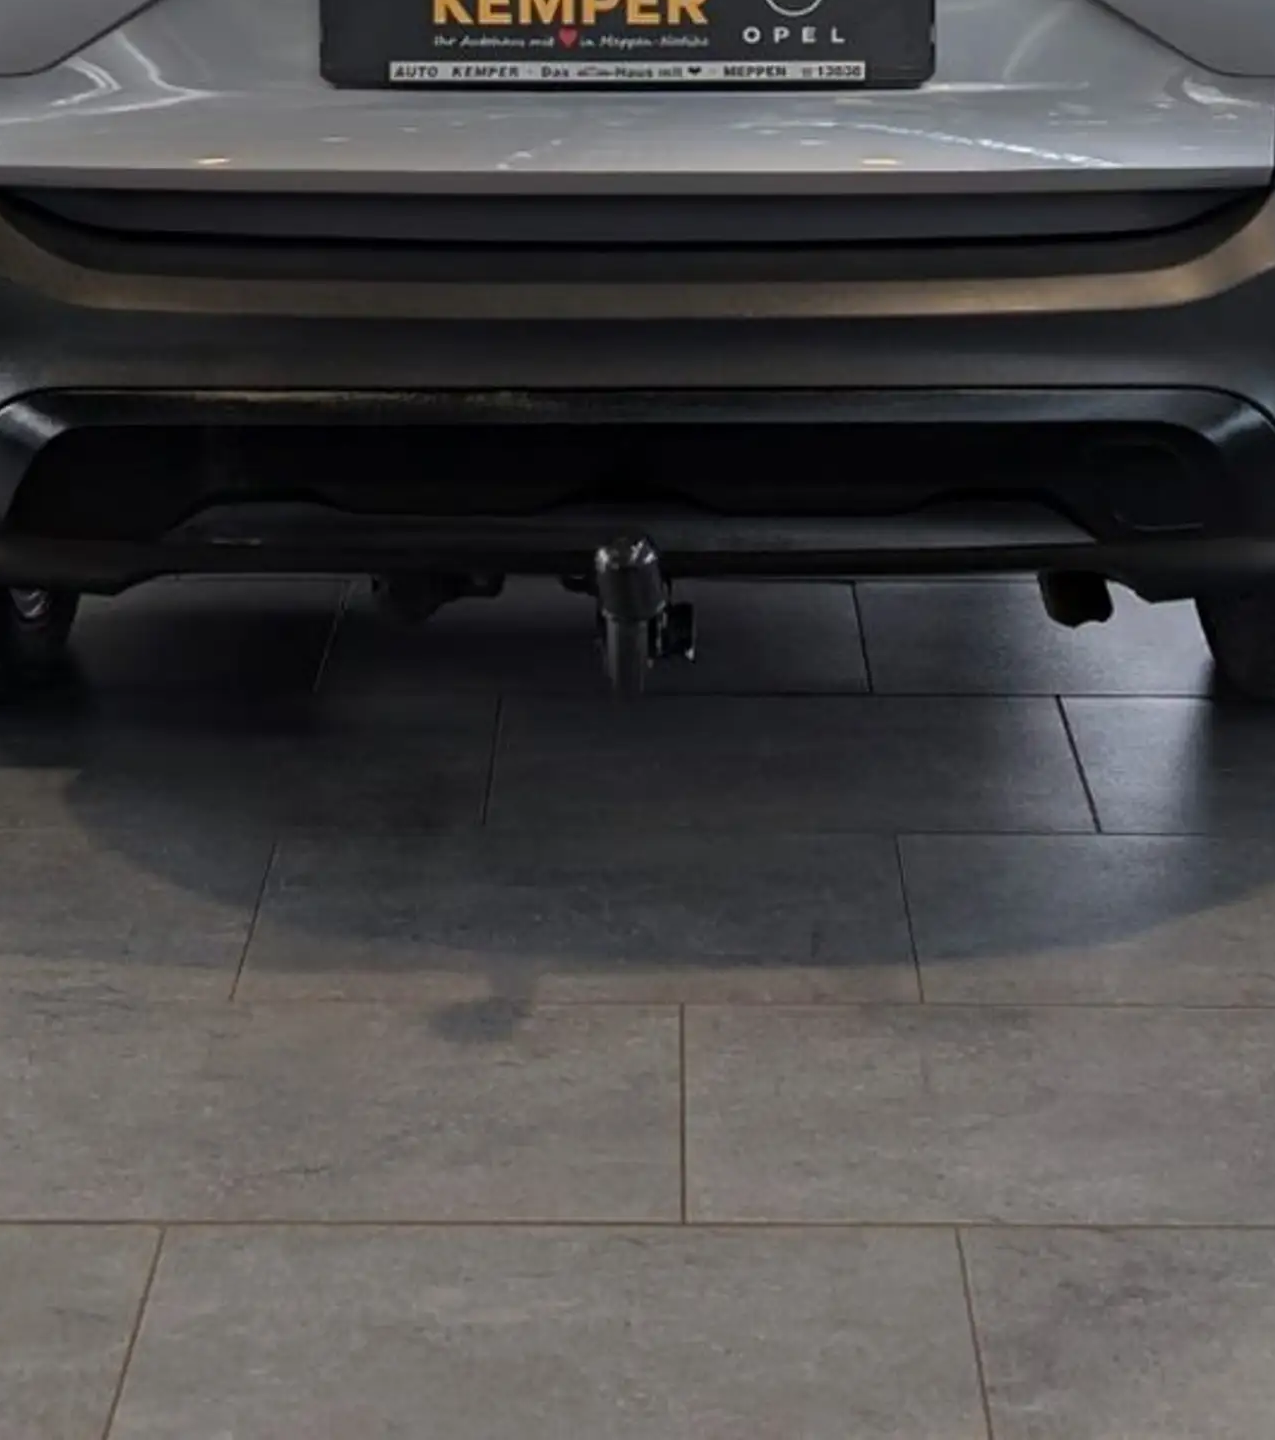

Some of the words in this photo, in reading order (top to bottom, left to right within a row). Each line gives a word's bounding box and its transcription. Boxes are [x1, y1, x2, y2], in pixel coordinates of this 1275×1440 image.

[742, 26, 846, 45] OPEL
[393, 65, 439, 78] AUTO
[451, 65, 520, 78] KEMPER
[723, 65, 787, 78] MEPPEN
